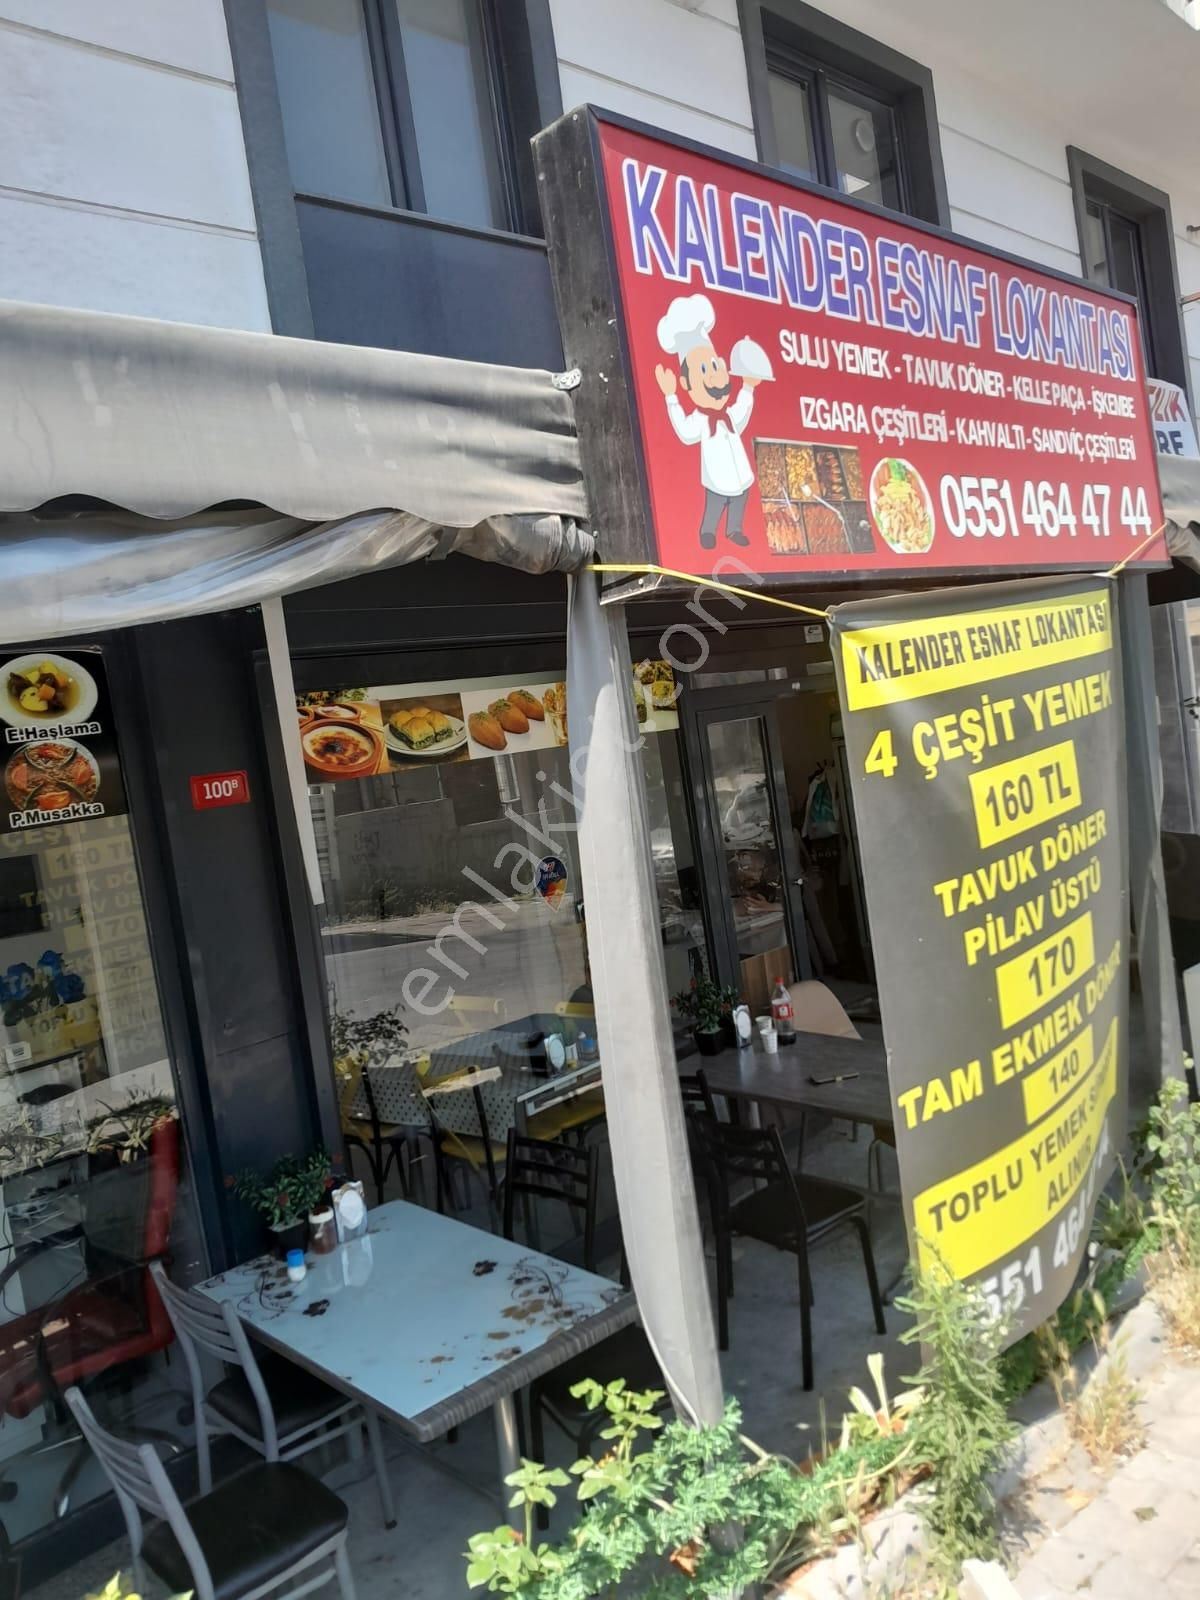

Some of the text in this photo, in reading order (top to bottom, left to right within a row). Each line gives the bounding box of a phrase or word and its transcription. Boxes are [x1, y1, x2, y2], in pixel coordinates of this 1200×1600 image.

[622, 158, 1137, 382] KALENDER ESNAF LOKANTASI
[779, 329, 830, 369] SULU
[831, 340, 892, 379] YEMEK
[902, 354, 956, 390] TAVUK
[957, 362, 1006, 398] DÖNER
[1012, 375, 1051, 405] KELLE
[1051, 383, 1086, 416] PAÇA
[1091, 386, 1137, 419] İŞKEMBE
[800, 397, 871, 435] IZGARA
[871, 404, 949, 446] ÇEŞİTLERİ
[956, 417, 1026, 450] KAHVALTI
[1032, 427, 1085, 462] SANDVİÇ
[1085, 432, 1137, 465] ÇEŞİTLERİ
[940, 474, 1152, 538] 0551 464 47 44
[856, 636, 966, 684] KALENDER
[967, 619, 1022, 658] ESNAF
[864, 669, 1113, 781] 4 ÇEŞİT YEMEK
[10, 802, 104, 827] P.Musakka
[985, 760, 1072, 829] 160 TL
[933, 808, 1108, 918] TAVUK DÖNER
[964, 855, 1101, 967] PİLAV ÜSTÜ
[1028, 935, 1076, 997] 170
[897, 1058, 984, 1130] TAM
[991, 992, 1083, 1086] EKMEK
[1049, 1049, 1080, 1095] 140
[928, 1158, 1024, 1233] TOPLU
[1029, 1106, 1088, 1173] YEMEK
